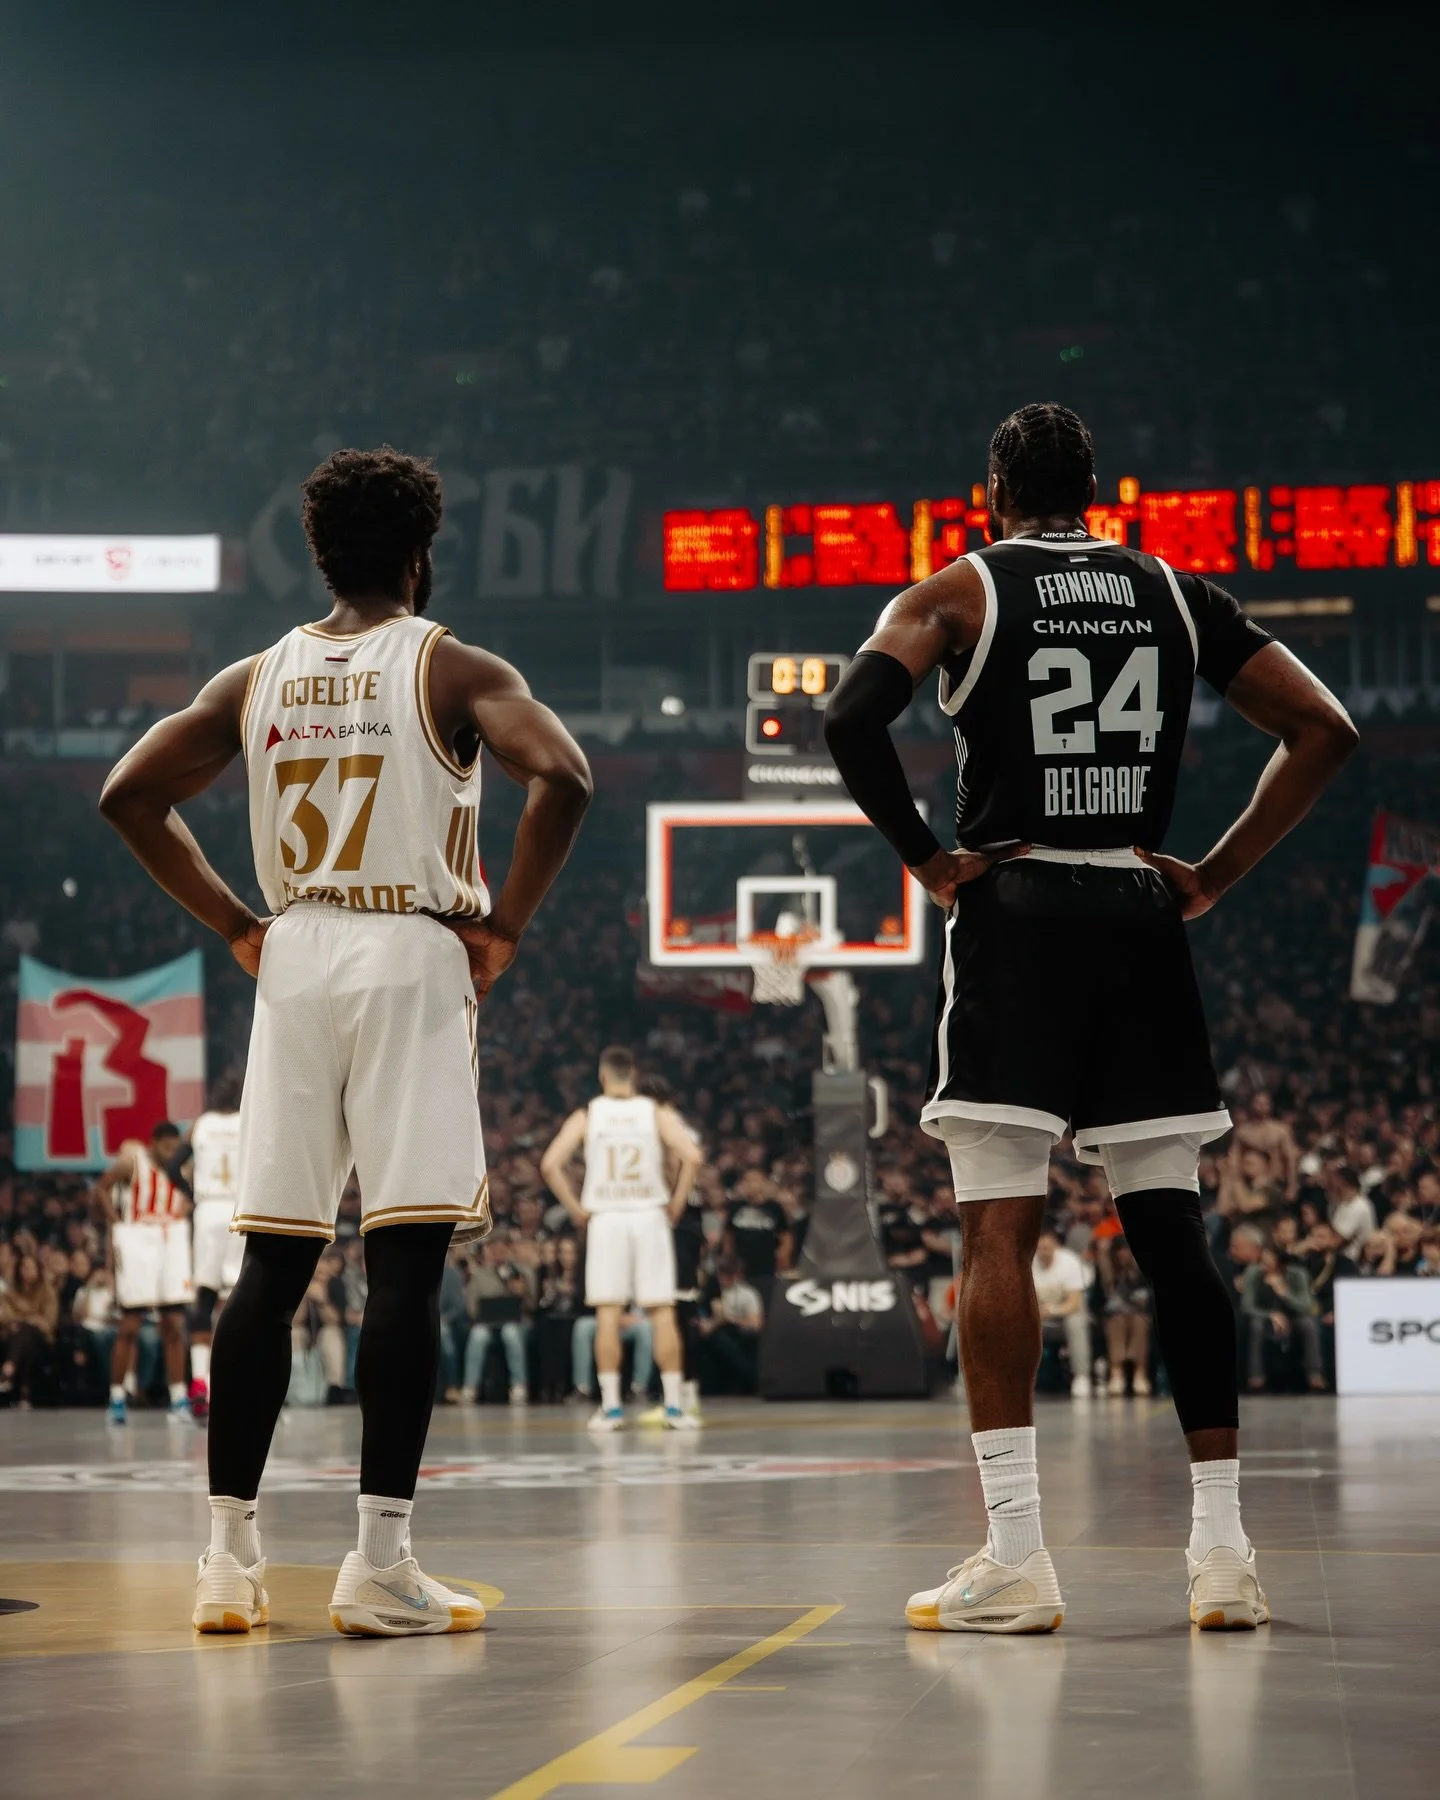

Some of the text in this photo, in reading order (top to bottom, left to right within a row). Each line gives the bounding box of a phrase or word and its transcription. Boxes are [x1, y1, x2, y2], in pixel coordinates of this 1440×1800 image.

[1067, 531, 1088, 539] PRO
[1034, 571, 1136, 608] FERNANDO
[1033, 619, 1153, 634] CHANGAN
[281, 671, 381, 709] OJELEYE
[1027, 646, 1164, 755] 24
[1044, 766, 1151, 816] BELGRADE
[275, 753, 385, 875] 37
[605, 1143, 642, 1181] 12
[831, 1280, 897, 1312] NIS
